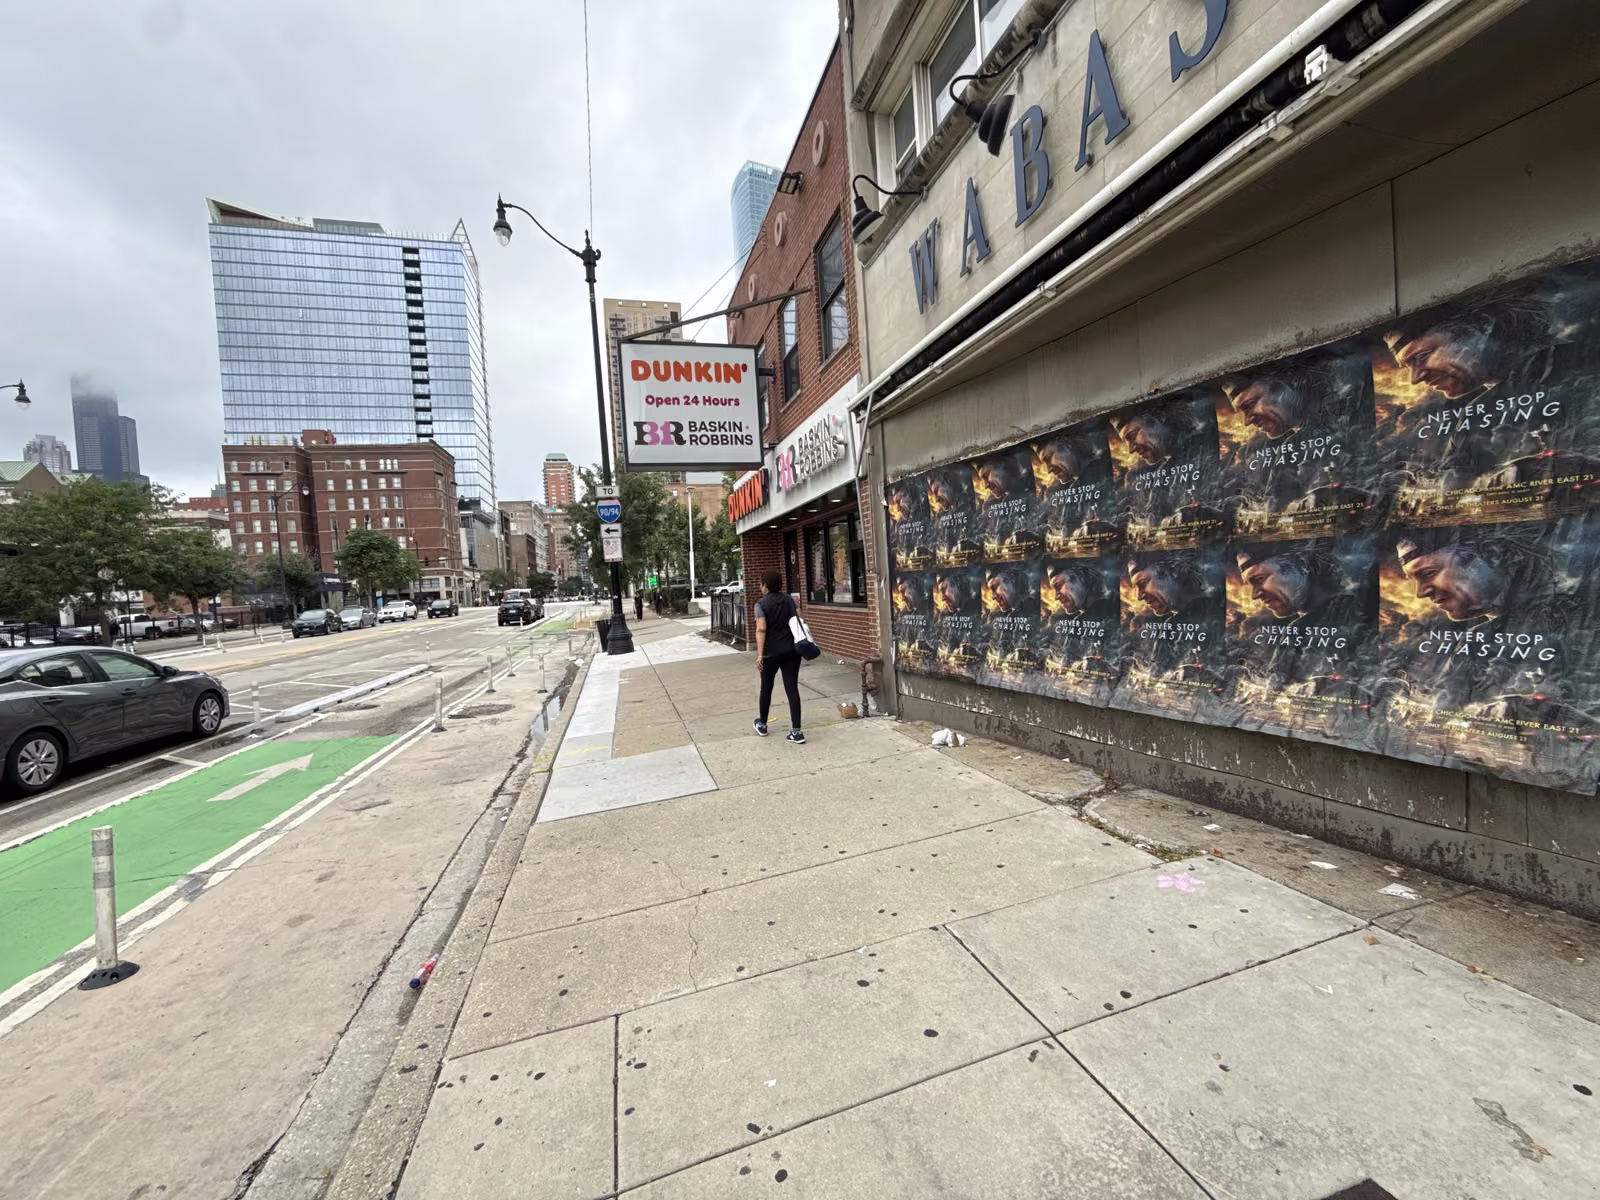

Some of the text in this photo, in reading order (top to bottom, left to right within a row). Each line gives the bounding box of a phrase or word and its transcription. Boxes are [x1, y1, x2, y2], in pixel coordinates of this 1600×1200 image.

[631, 359, 748, 384] DUNKIN'
[645, 394, 740, 408] Open 24 Hours
[1428, 391, 1545, 424] NEVER STOP
[688, 420, 743, 433] BASKIN
[1418, 401, 1561, 439] CHASING
[633, 420, 687, 446] BR
[689, 434, 753, 446] ROBBINS
[798, 414, 832, 456] BASKIN
[1256, 436, 1332, 458] NEVER STOP
[799, 435, 839, 478] ROBBINS
[1249, 444, 1341, 470] CHASING
[1139, 463, 1194, 480] NEVER STOP
[1135, 470, 1200, 491] CHASING
[1506, 482, 1527, 490] AMC
[1529, 478, 1554, 487] RIVER
[1556, 475, 1580, 484] EAST
[1051, 490, 1101, 506] CHASING
[1055, 484, 1095, 497] NEVER STOP
[990, 499, 1022, 510] NEVER STOP
[1501, 496, 1533, 505] AUGUST
[599, 507, 619, 517] 90/94
[988, 504, 1026, 518] CHASING
[992, 622, 1031, 631] CHASING
[1059, 619, 1101, 628] NEVER STOP
[1145, 621, 1200, 632] NEVER STOP
[1261, 625, 1338, 636] NEVER STOP
[1055, 626, 1105, 637] CHASING
[1140, 629, 1207, 642] CHASING
[1429, 630, 1544, 646] NEVER STOP
[1254, 634, 1347, 649] CHASING
[1418, 640, 1557, 661] CHASING
[1516, 719, 1541, 729] RIVER
[1543, 723, 1567, 732] EAST
[1568, 726, 1580, 734] 21
[1487, 731, 1518, 741] AUGUST
